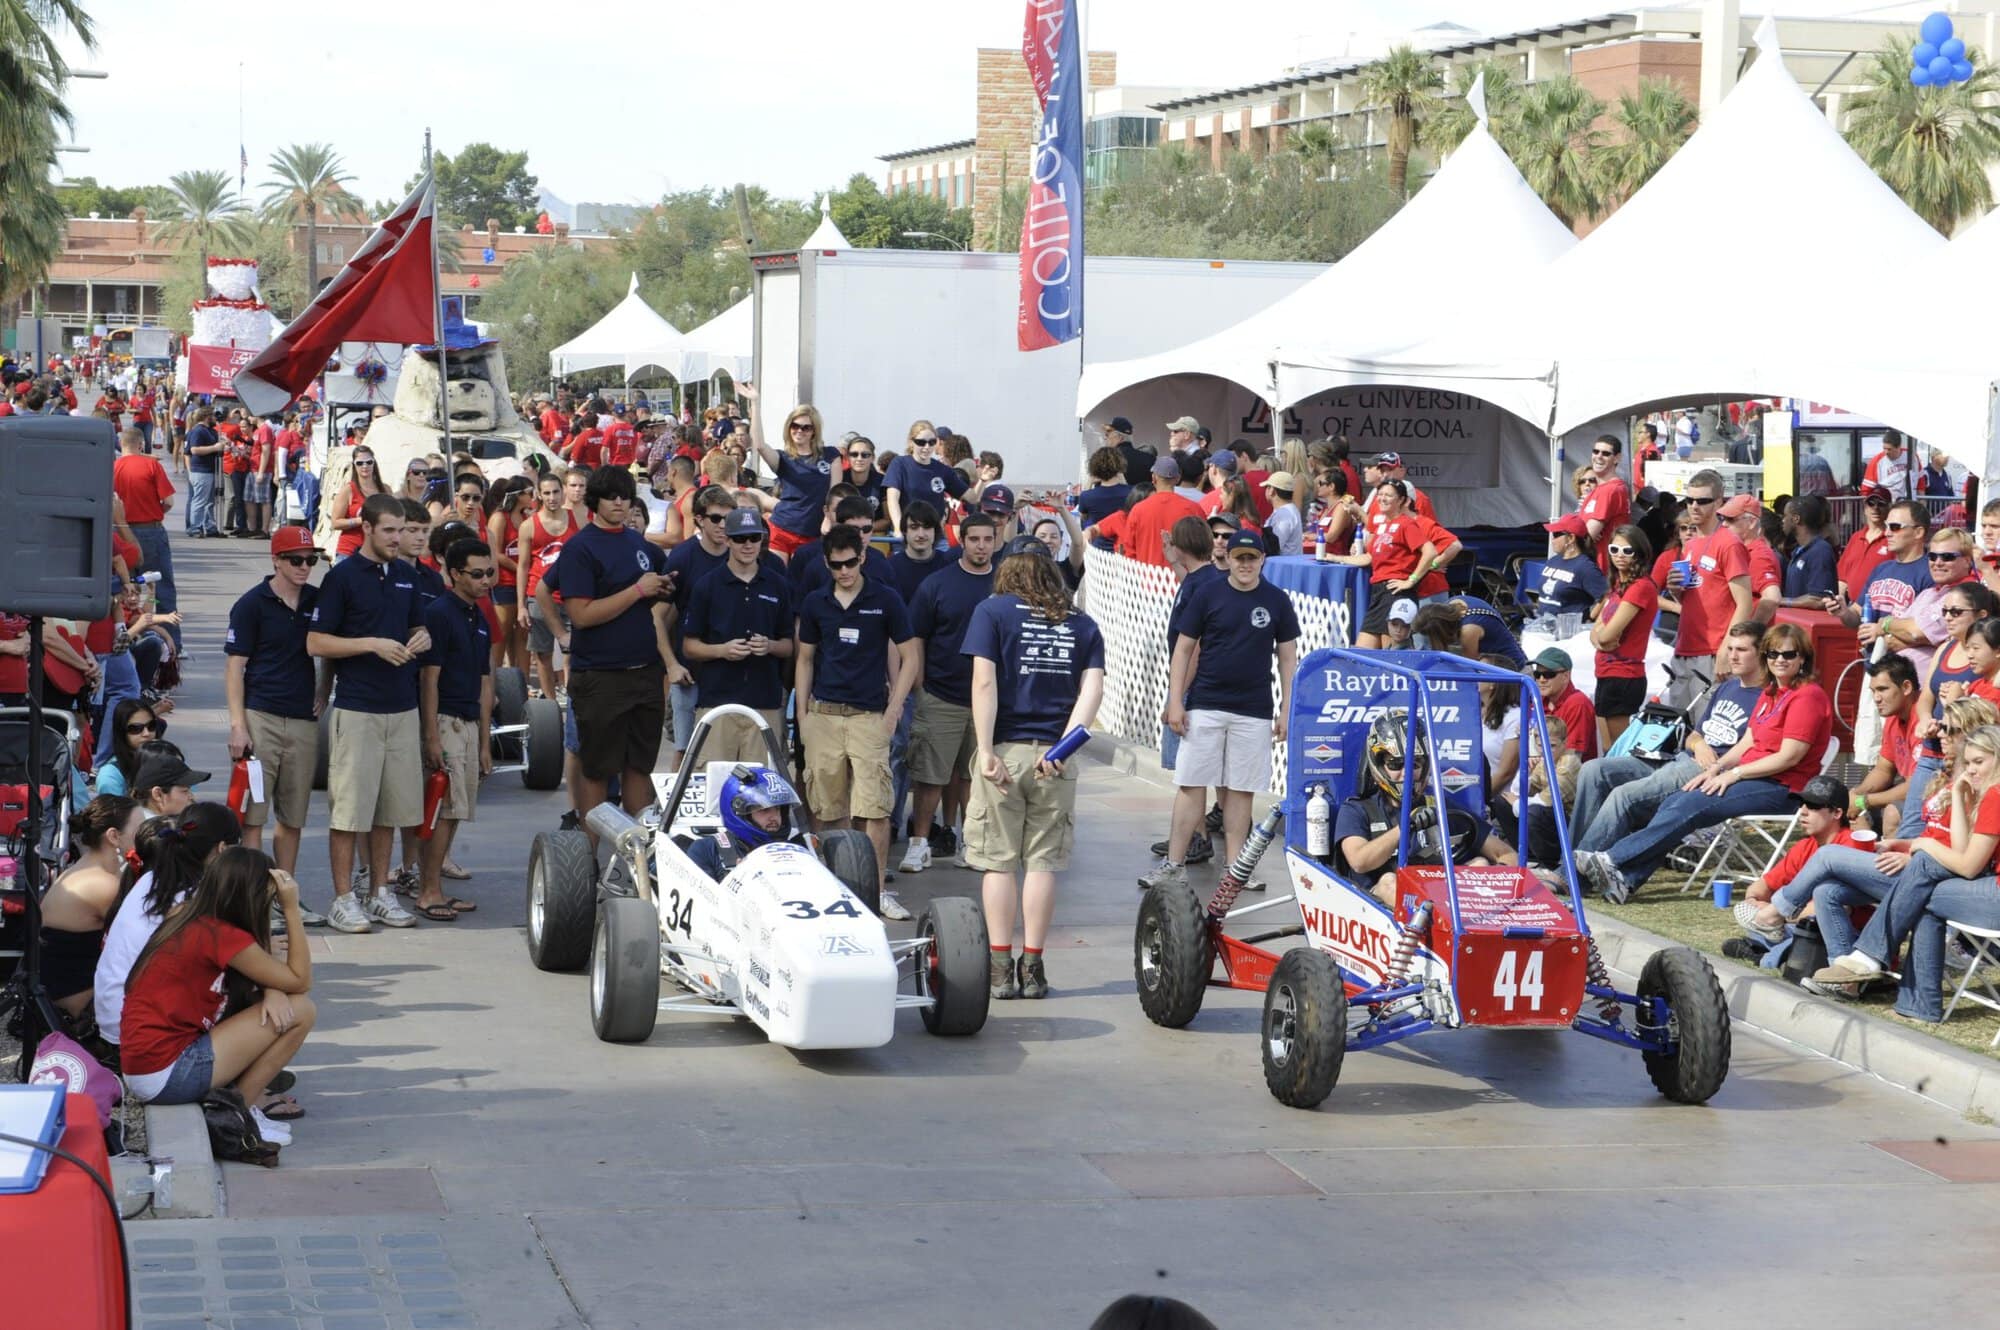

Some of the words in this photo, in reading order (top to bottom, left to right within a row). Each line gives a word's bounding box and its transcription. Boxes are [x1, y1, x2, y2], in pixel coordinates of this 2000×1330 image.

[1323, 416, 1352, 437] OF
[1359, 413, 1465, 439] ARIZONA
[1324, 670, 1458, 697] Raython
[667, 888, 694, 940] 34
[781, 900, 863, 919] 34
[1300, 903, 1392, 967] WILDCATS
[1493, 951, 1544, 1011] 44
